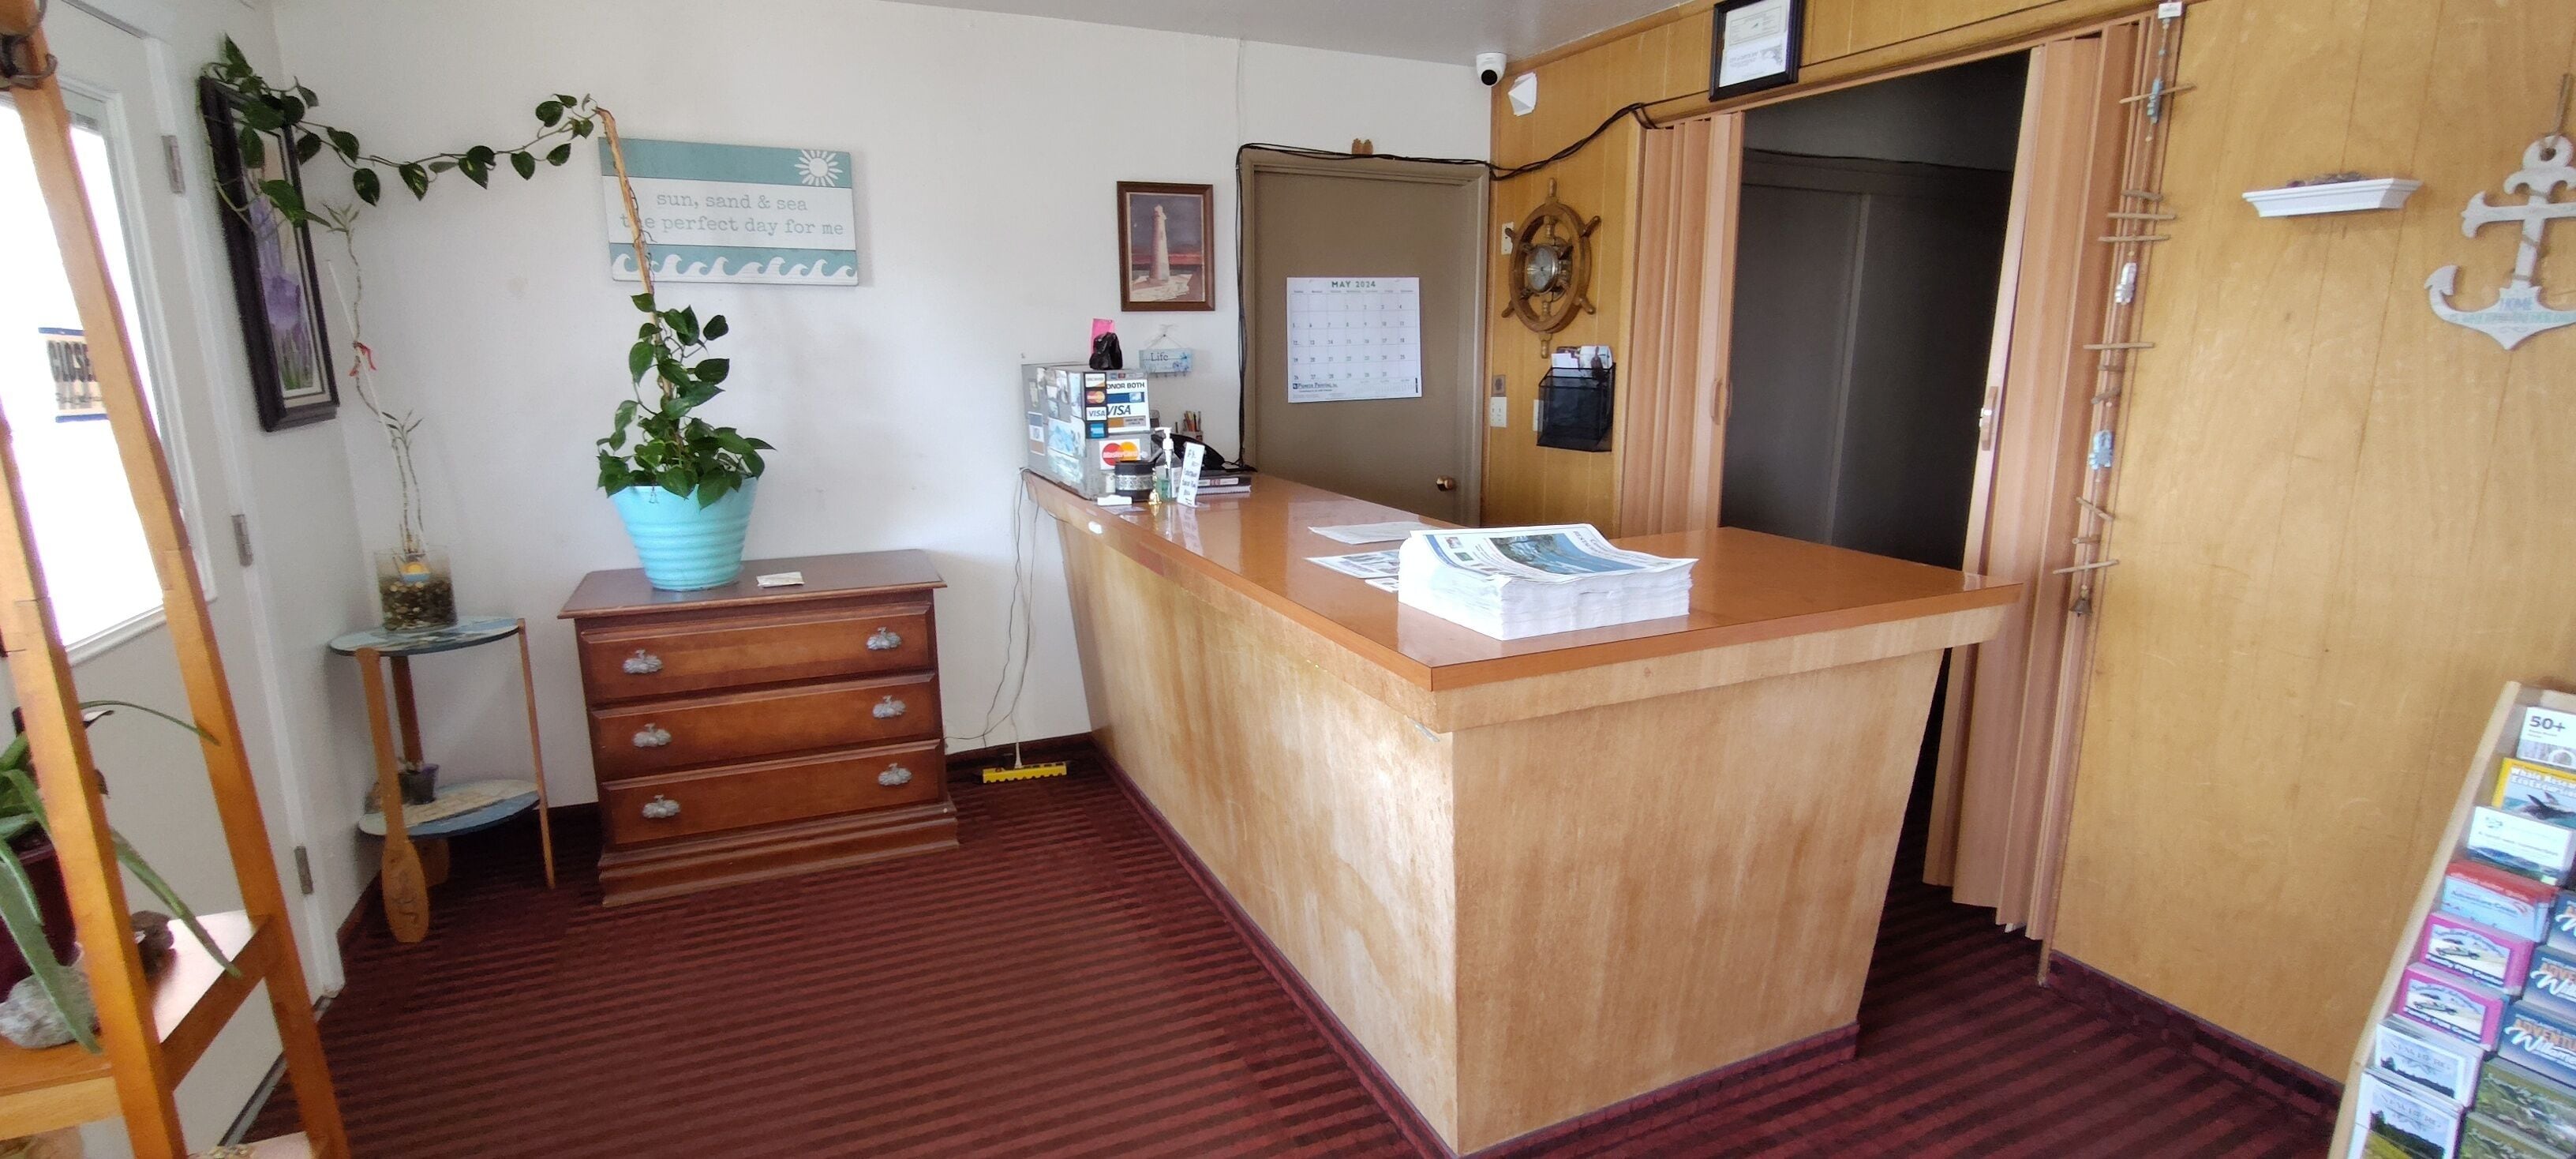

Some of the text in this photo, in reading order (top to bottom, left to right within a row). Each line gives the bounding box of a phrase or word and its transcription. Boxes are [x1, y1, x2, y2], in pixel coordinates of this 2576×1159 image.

[657, 193, 808, 211] sun, sand & sea
[620, 214, 844, 236] te perfect day for me
[1151, 351, 1169, 362] Life
[1107, 404, 1132, 416] VISA
[2529, 715, 2567, 733] 50+
